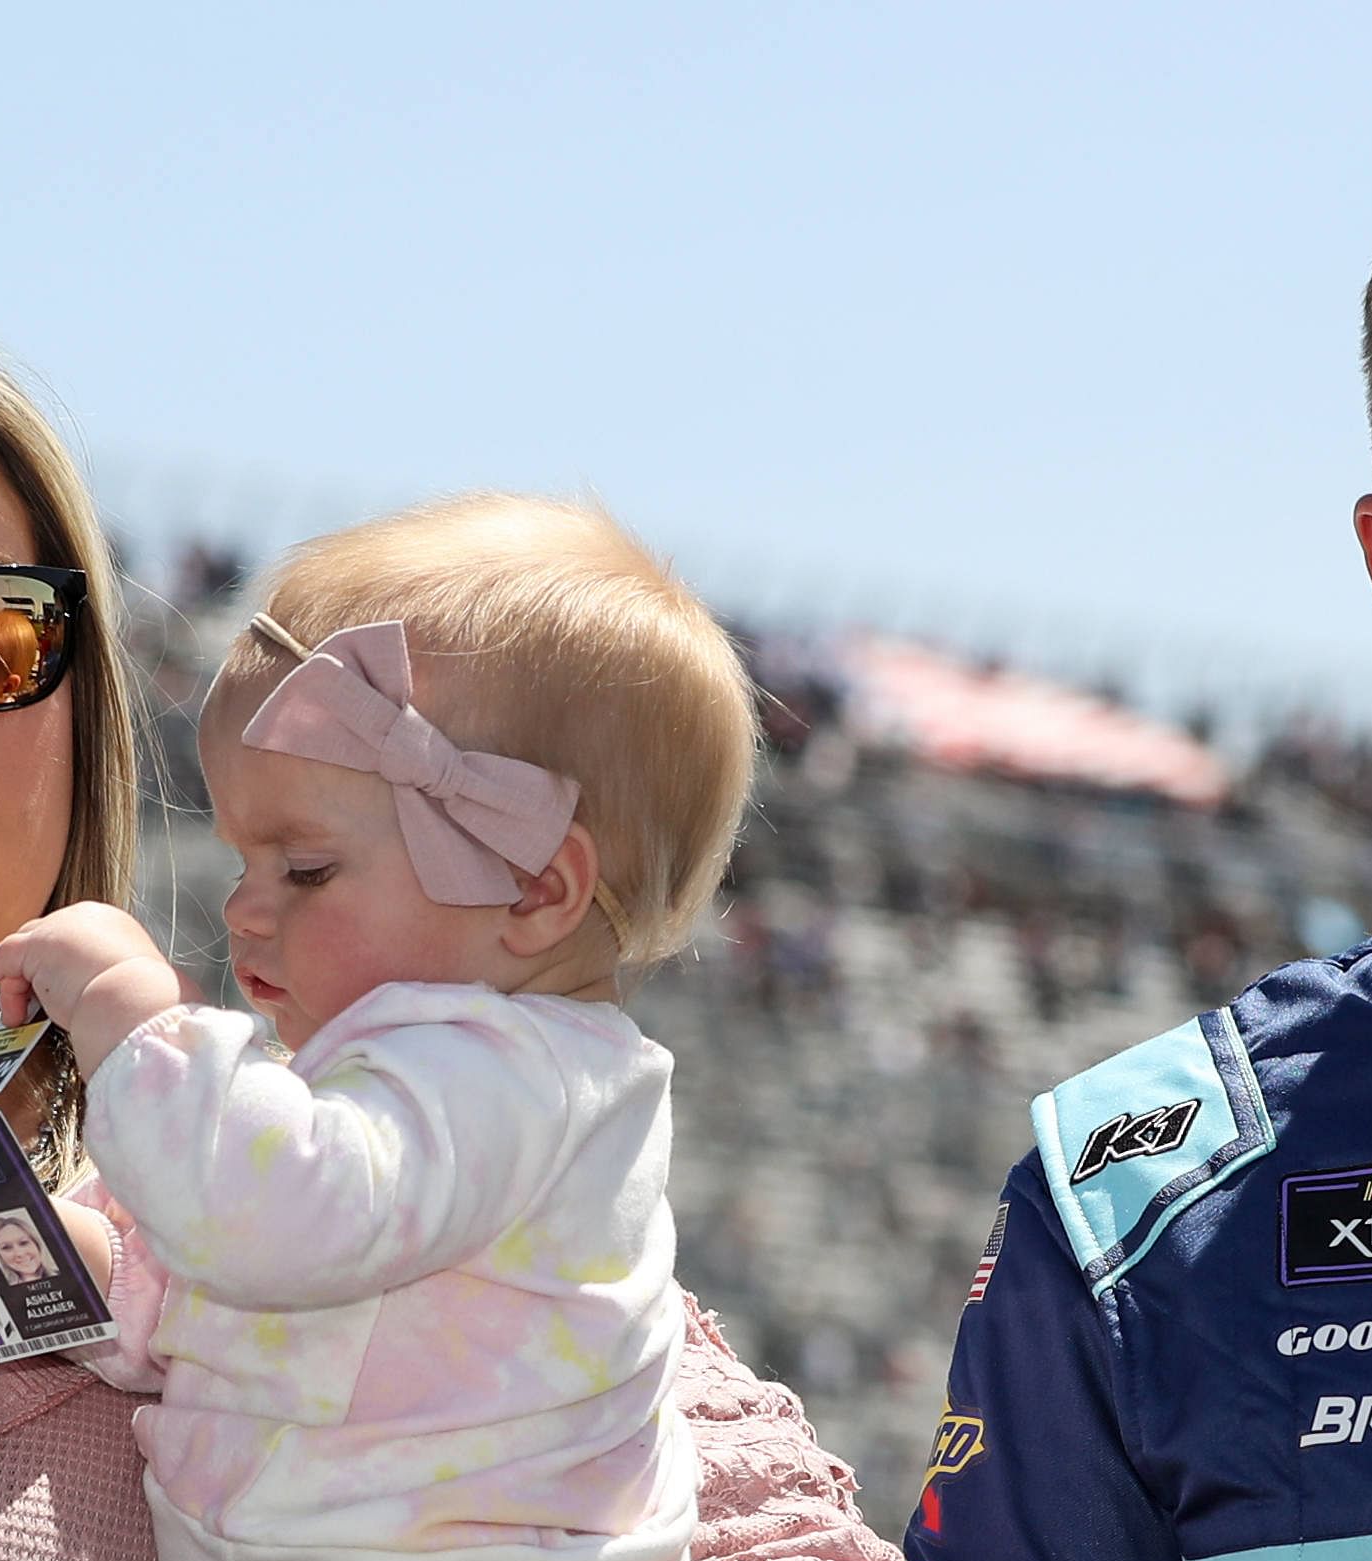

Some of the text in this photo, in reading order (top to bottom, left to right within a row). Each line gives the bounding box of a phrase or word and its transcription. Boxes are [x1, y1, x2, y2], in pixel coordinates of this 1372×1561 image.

[1070, 1098, 1202, 1185] K1
[25, 1290, 64, 1307] ASHLEY
[27, 1300, 76, 1319] ALLGAIER
